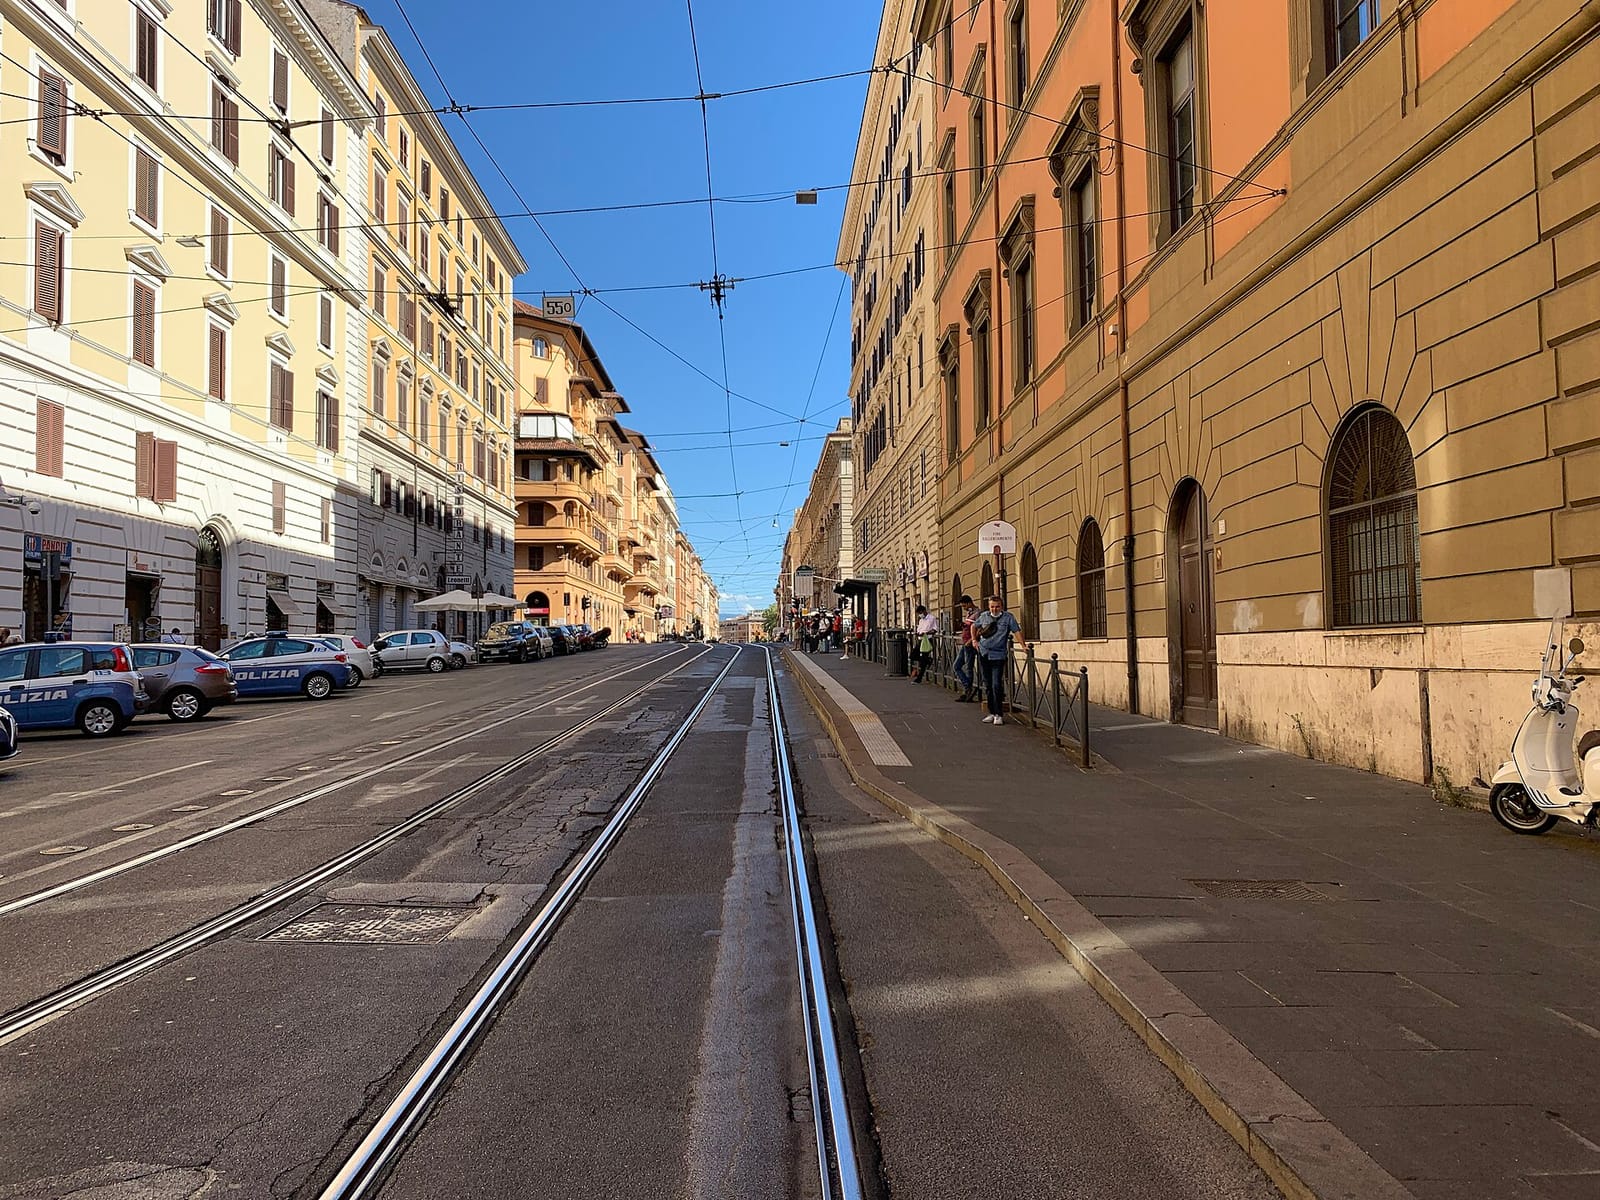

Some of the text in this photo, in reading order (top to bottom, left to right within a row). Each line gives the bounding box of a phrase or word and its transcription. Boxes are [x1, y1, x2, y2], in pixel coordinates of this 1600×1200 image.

[455, 463, 463, 574] RISTORANTE
[233, 669, 299, 680] OLIZIA
[0, 690, 68, 704] LIZIA
